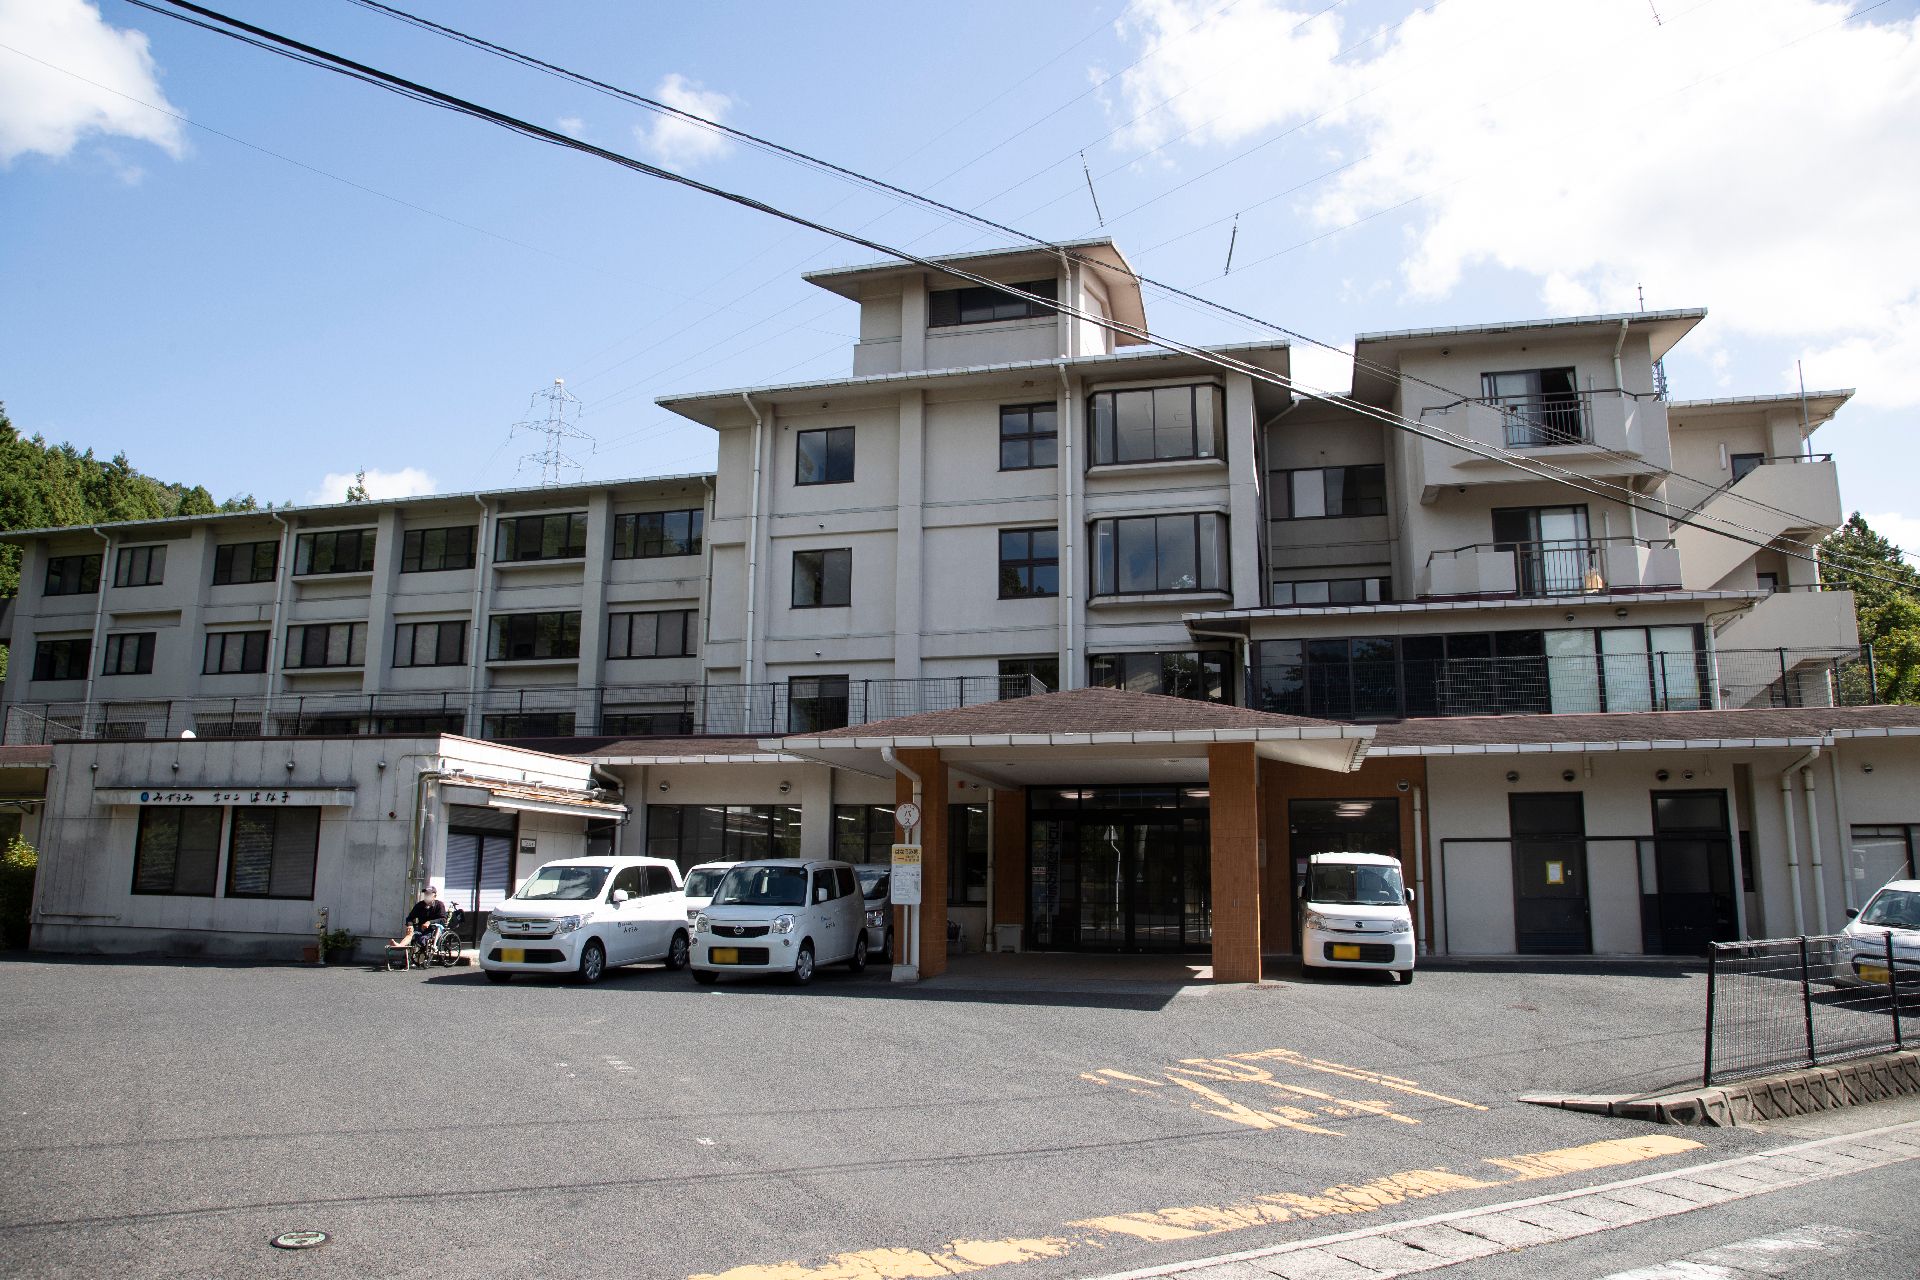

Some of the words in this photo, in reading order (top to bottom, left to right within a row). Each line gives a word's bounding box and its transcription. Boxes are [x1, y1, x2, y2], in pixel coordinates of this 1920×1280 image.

[152, 792, 194, 802] みずうみ
[213, 791, 240, 802] サロン
